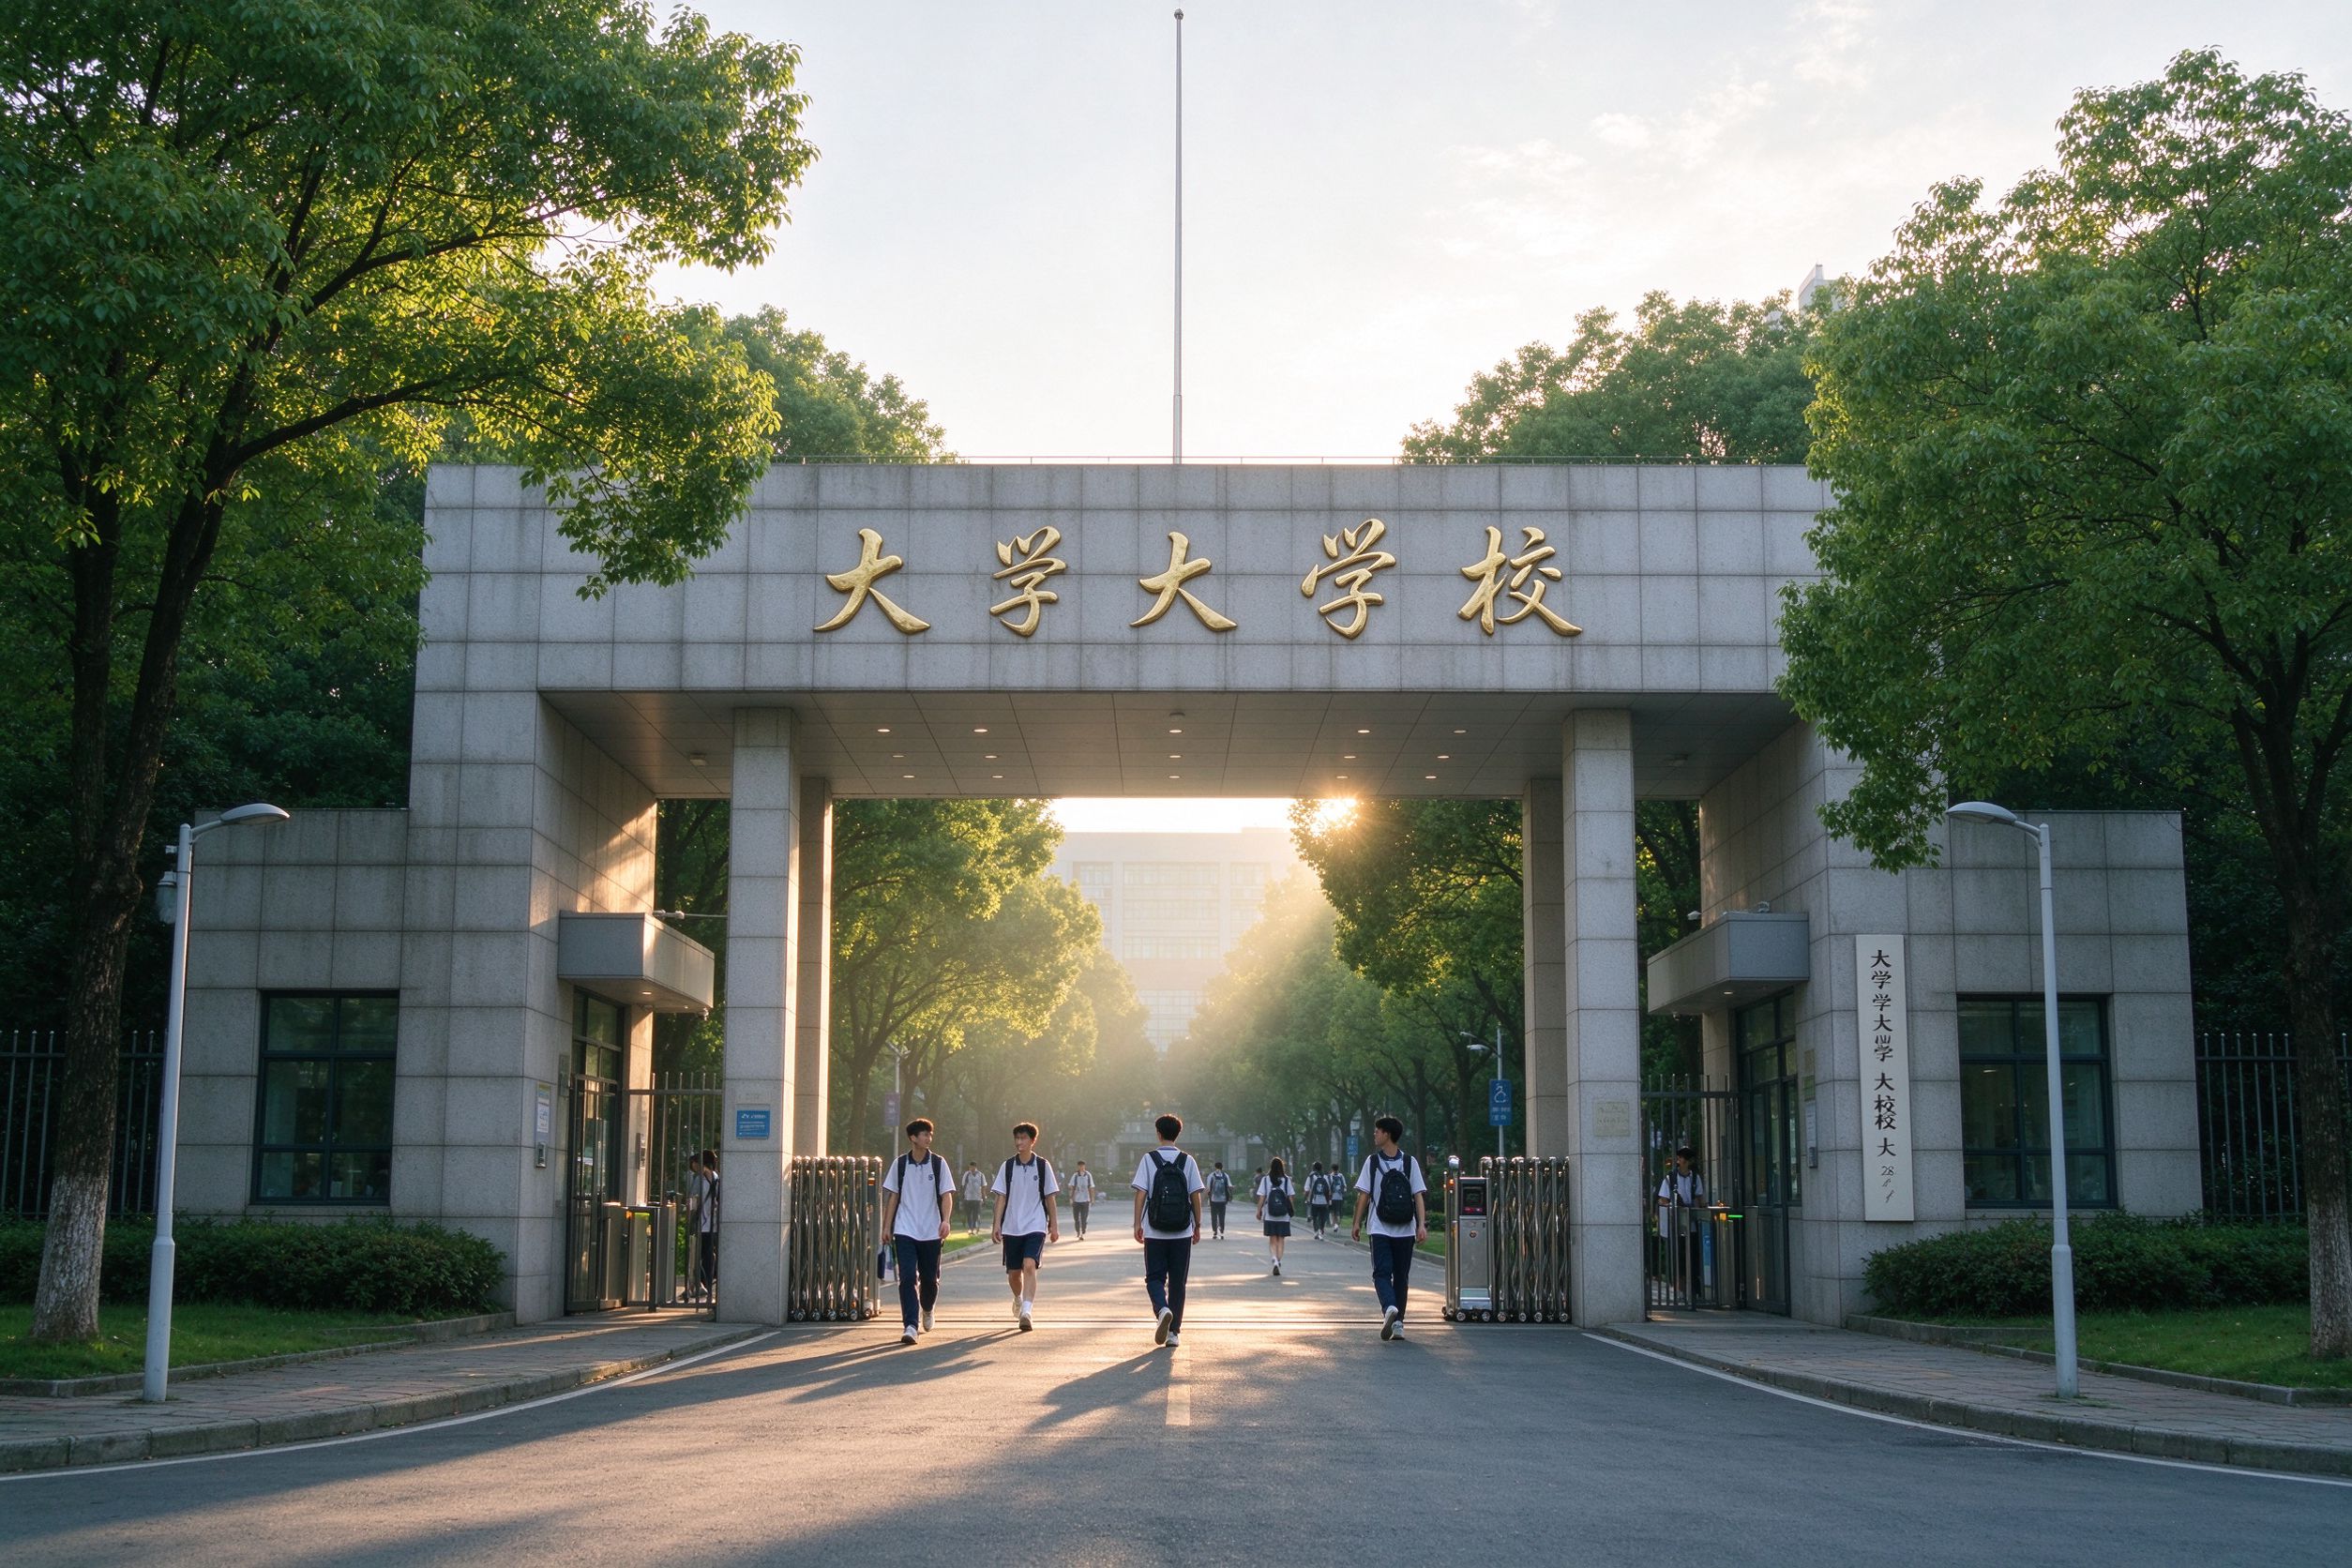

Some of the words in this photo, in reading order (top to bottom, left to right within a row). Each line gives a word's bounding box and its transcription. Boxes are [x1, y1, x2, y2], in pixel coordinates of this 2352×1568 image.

[813, 519, 1582, 640] 大学大学校
